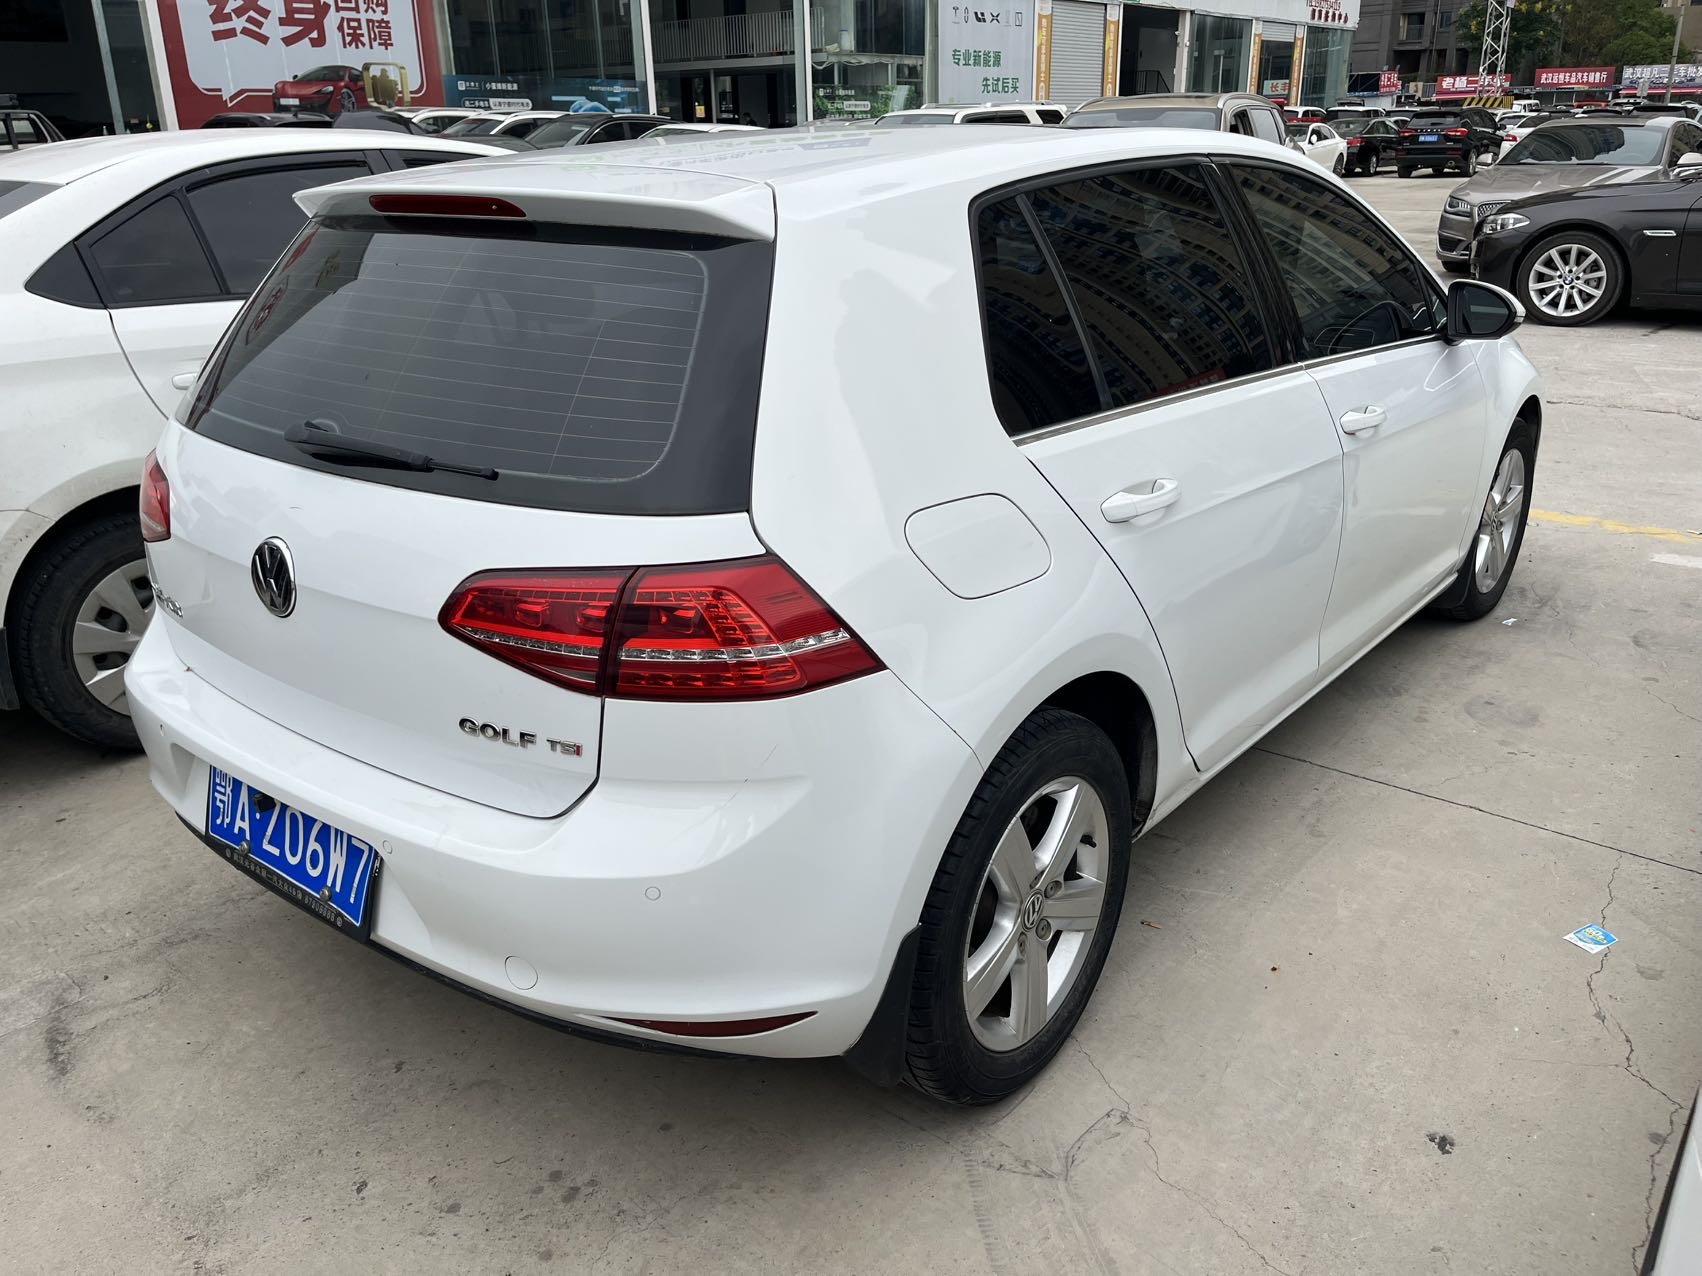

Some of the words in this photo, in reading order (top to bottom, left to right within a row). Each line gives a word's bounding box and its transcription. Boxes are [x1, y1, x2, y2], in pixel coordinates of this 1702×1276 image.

[209, 0, 332, 47] 终身
[337, 16, 393, 50] 保障
[952, 49, 1002, 67] 专业新能源
[981, 77, 1019, 94] 先试后买
[459, 717, 537, 750] GOLF
[546, 736, 583, 758] TSI
